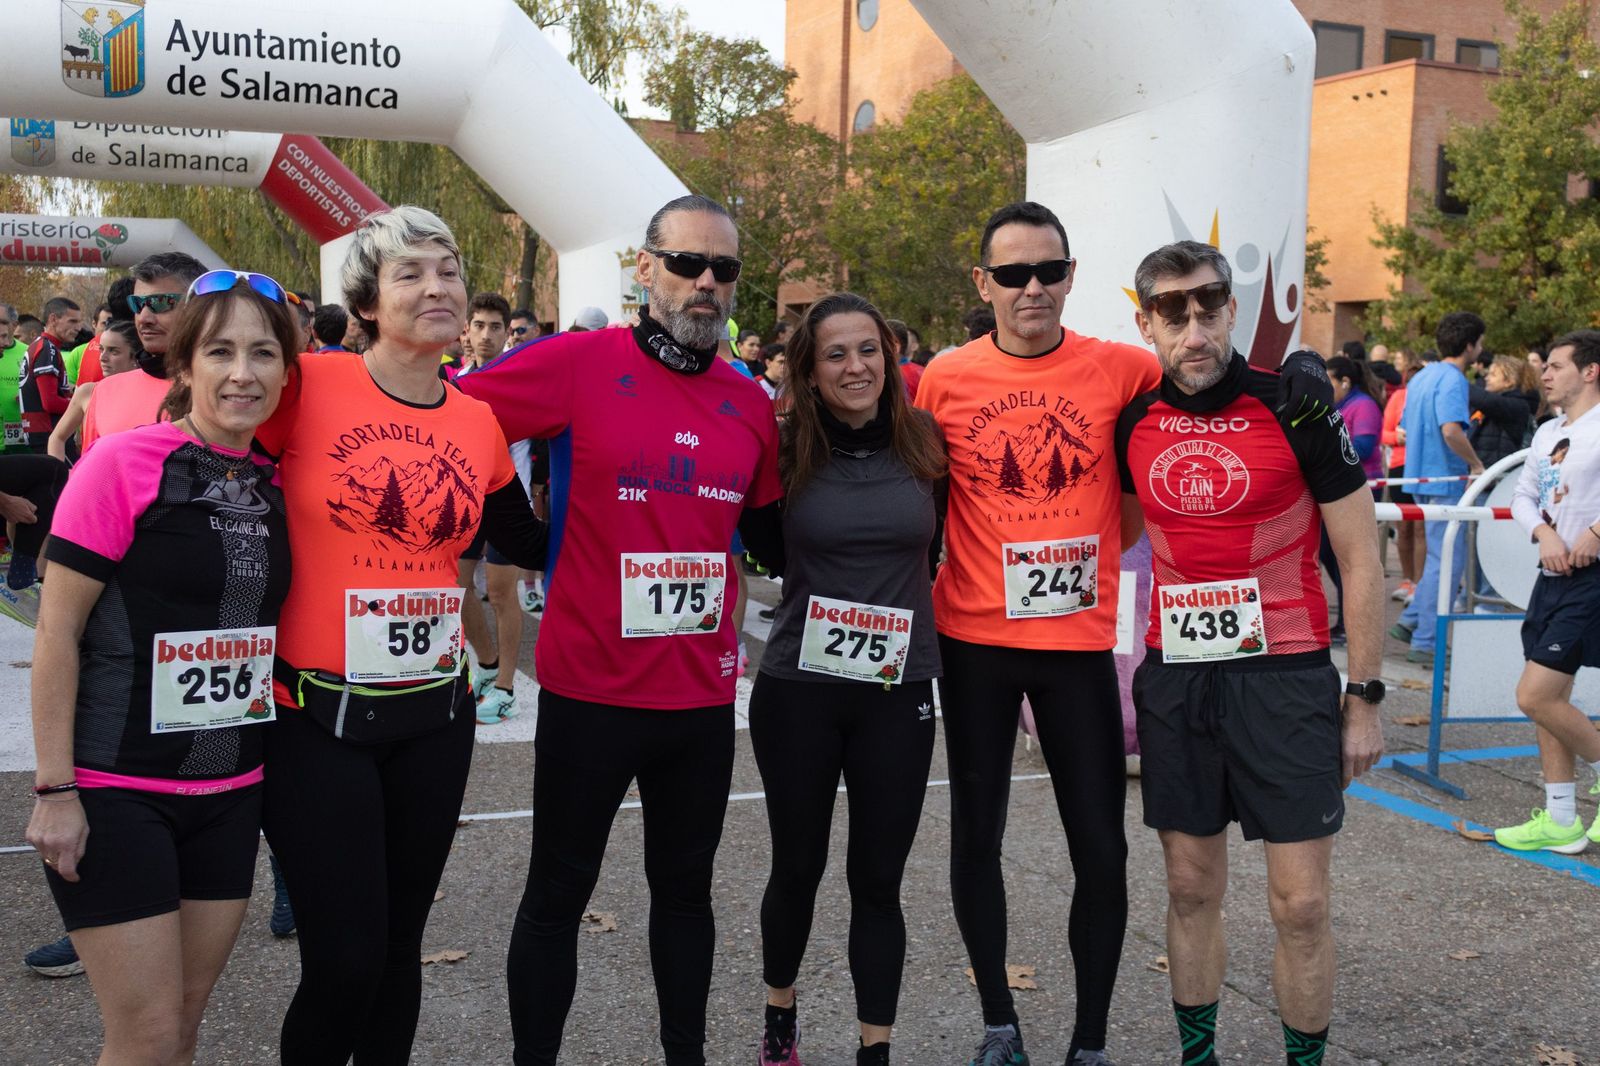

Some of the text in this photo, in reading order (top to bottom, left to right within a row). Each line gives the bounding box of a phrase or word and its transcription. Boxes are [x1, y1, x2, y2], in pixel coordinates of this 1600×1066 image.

[165, 19, 401, 68] Ayuntamiento
[166, 65, 399, 109] de Salamanca
[72, 143, 248, 173] de Salamanca
[278, 159, 351, 227] DEPORTISTAS
[287, 143, 369, 220] CON NUESTROS
[1, 219, 91, 239] ristería
[0, 239, 102, 264] dunia
[963, 391, 1093, 443] MORTADELA TEAM
[326, 423, 478, 482] MORTADELA TEAM
[674, 431, 700, 449] edp
[1175, 442, 1203, 456] ULTRA
[1206, 443, 1217, 457] EL
[617, 487, 648, 501] 21K
[209, 516, 224, 531] EL
[987, 508, 1080, 523] SALAMANCA
[232, 559, 263, 570] PICOS DE
[625, 558, 725, 579] bedunia
[1005, 541, 1097, 566] bedunia
[232, 569, 264, 578] EUROPA
[1028, 565, 1083, 597] 242
[350, 593, 461, 617] bedunia
[648, 582, 706, 614] 175
[1162, 585, 1257, 609] bedunia
[810, 601, 909, 633] bedunia
[1180, 609, 1240, 641] 438
[158, 633, 273, 664] bedunia
[388, 621, 431, 656] 58
[824, 628, 888, 662] 275
[182, 663, 253, 705] 256
